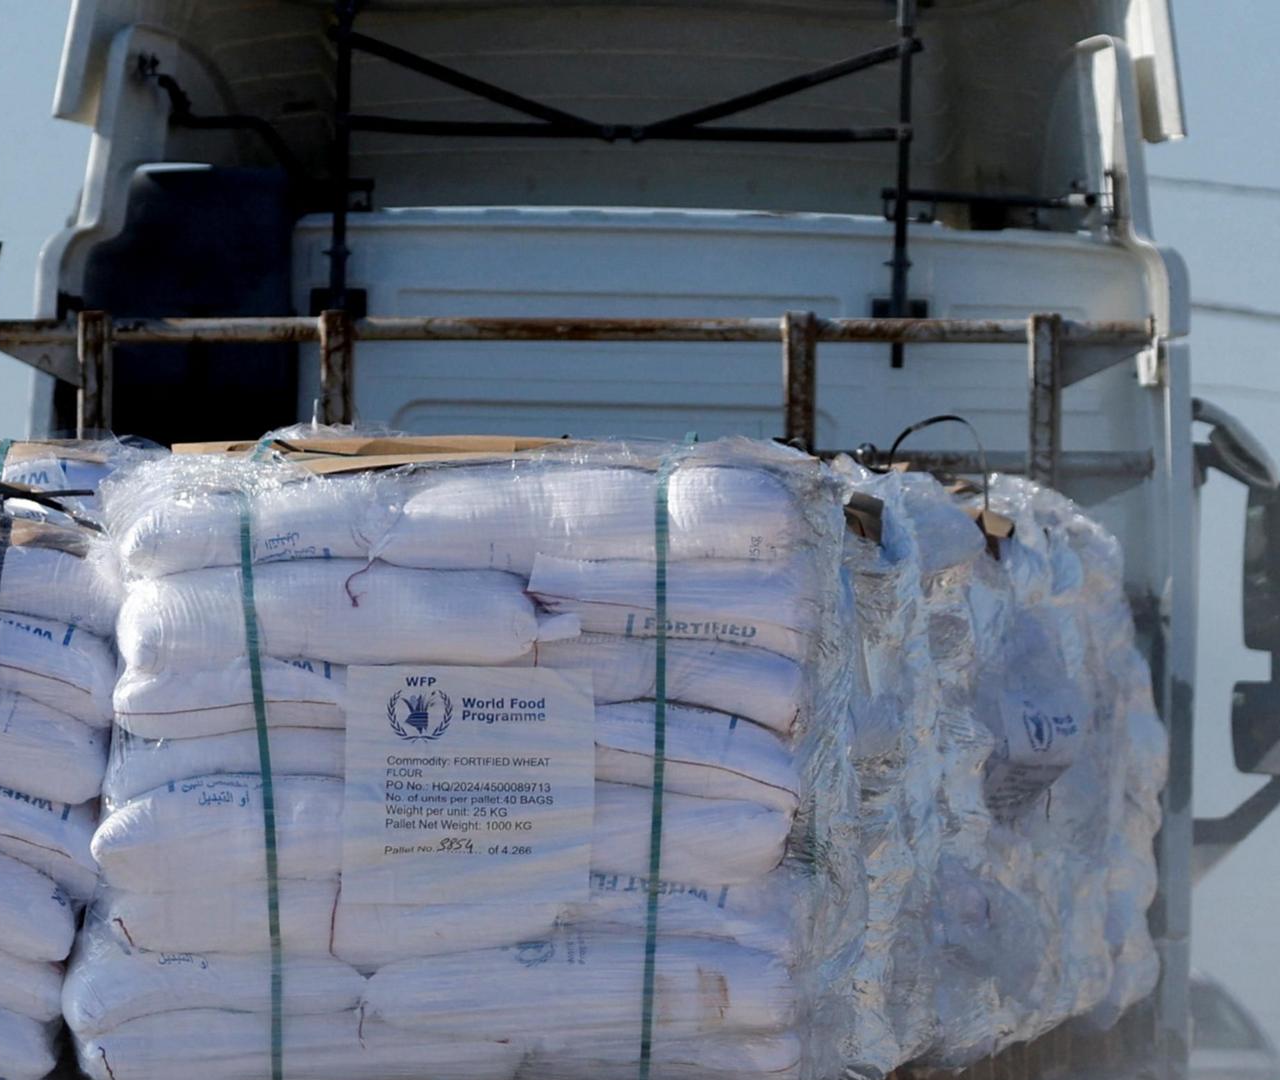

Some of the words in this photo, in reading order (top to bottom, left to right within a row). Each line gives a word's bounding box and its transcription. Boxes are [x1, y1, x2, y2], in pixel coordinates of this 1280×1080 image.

[406, 677, 436, 686] WFP
[462, 698, 504, 709] World
[510, 698, 545, 709] Food
[462, 711, 546, 723] Programme
[387, 756, 450, 767] Commodity:
[454, 757, 509, 766] FORTIFIED
[512, 758, 551, 766] WHEAT
[386, 769, 422, 778] FLOUR
[386, 782, 403, 790] PO
[432, 783, 551, 792] HQ/2024/4500089713
[408, 794, 418, 802] of
[421, 795, 447, 803] units
[450, 796, 467, 806] per
[521, 796, 553, 805] BAGS
[386, 806, 422, 818] Weight
[426, 809, 444, 819] per
[447, 807, 469, 817] unit:
[473, 808, 487, 816] 25
[490, 808, 507, 817] KG
[385, 819, 415, 829] Pallet
[419, 820, 438, 829] Net
[441, 820, 481, 831] Weight:
[486, 822, 511, 831] 1000
[515, 822, 532, 830] KG
[384, 846, 414, 855] Pallet
[488, 847, 499, 855] of
